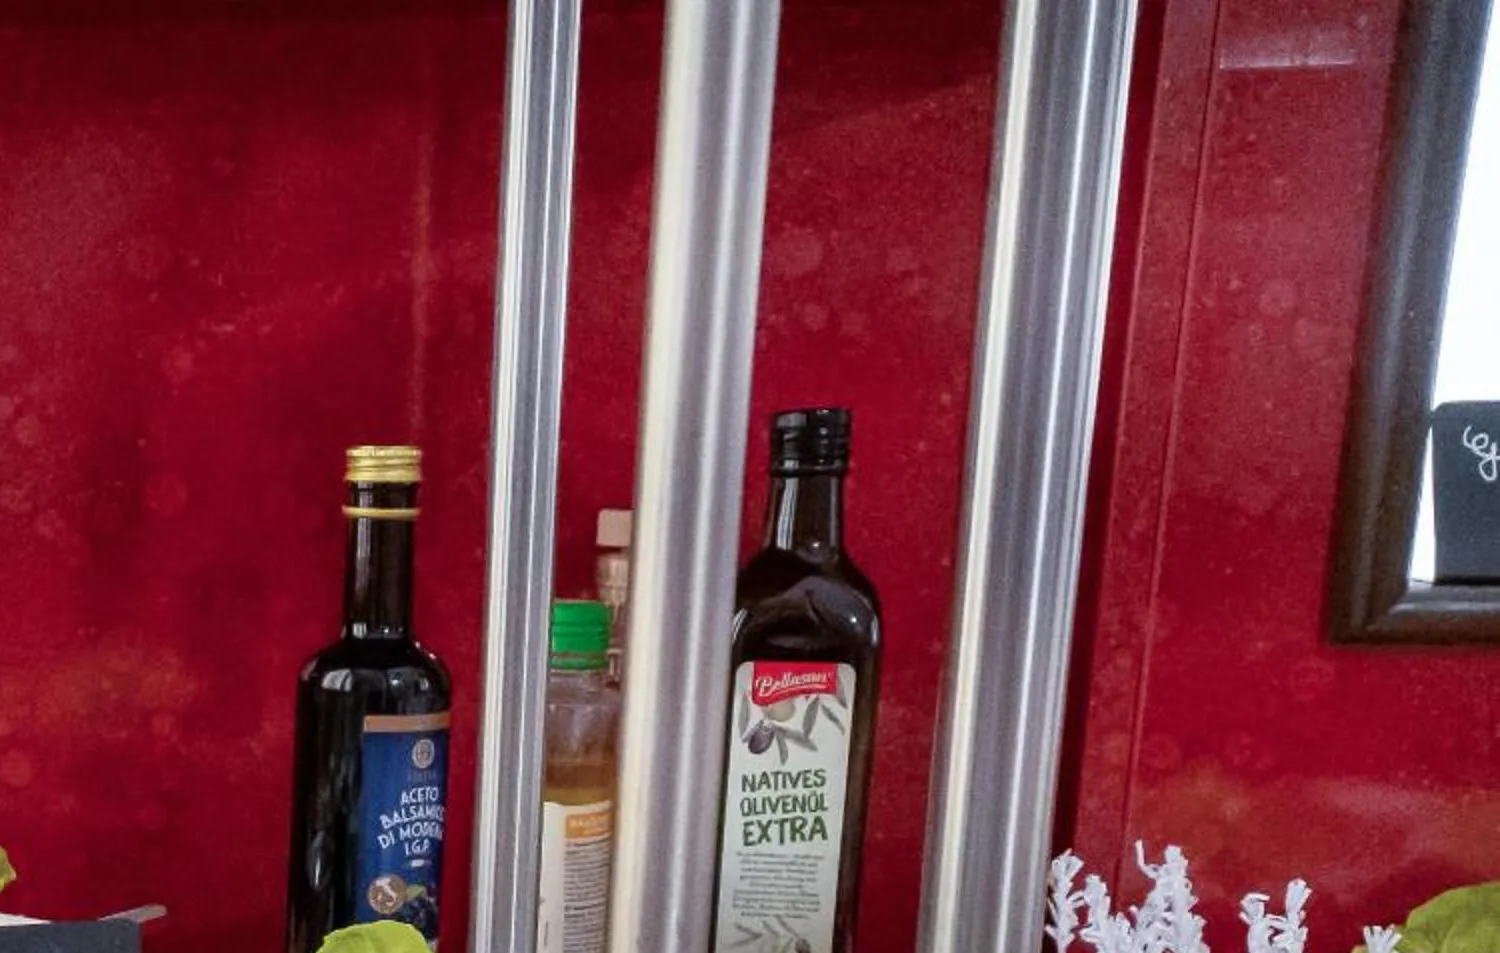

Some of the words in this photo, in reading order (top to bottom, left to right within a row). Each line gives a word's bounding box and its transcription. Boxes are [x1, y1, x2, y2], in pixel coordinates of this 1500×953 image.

[741, 768, 826, 793] NATIVES
[401, 787, 439, 805] ACETO
[378, 831, 395, 849] DI
[743, 816, 828, 846] EXTRA
